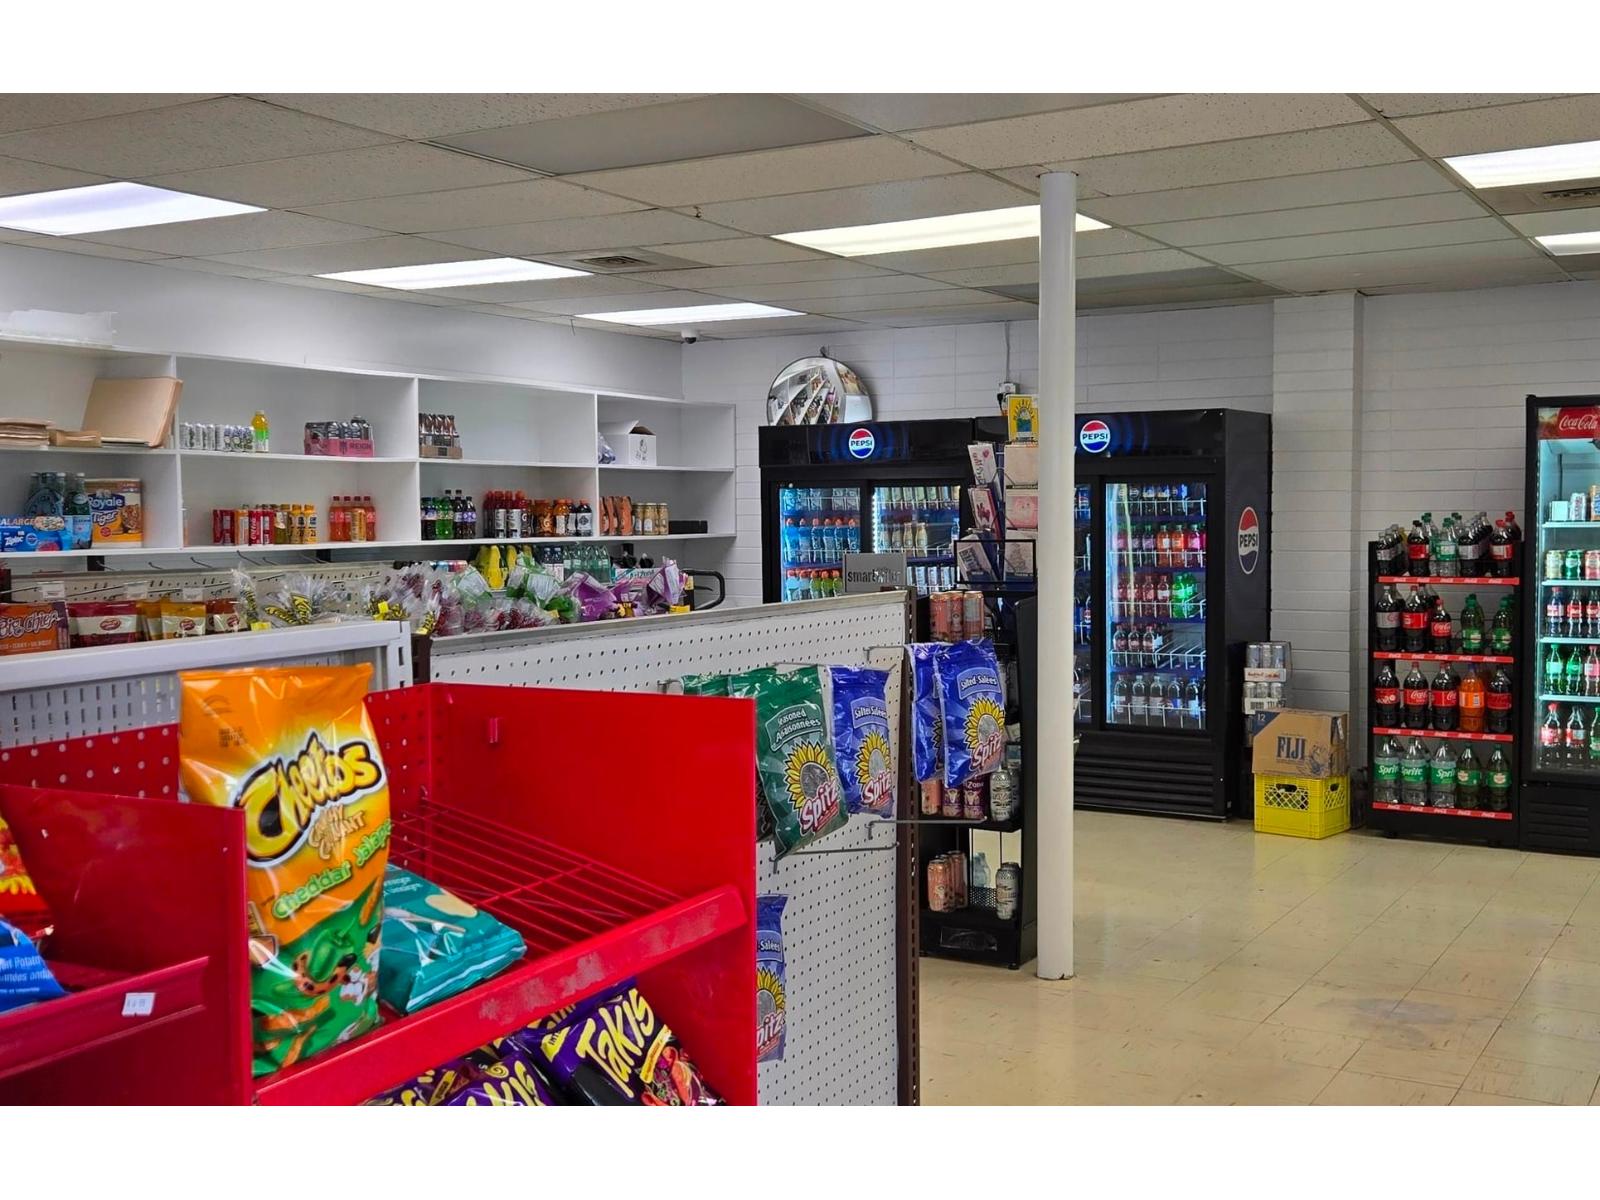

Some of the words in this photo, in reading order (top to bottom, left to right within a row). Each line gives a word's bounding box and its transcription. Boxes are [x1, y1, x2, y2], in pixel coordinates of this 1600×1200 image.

[850, 439, 873, 447] PEPSI
[1082, 433, 1109, 441] PEPSI
[88, 497, 123, 509] Royale
[93, 511, 117, 526] Tiger
[1239, 533, 1259, 548] PEPSI
[1257, 713, 1266, 722] 12
[971, 734, 1003, 770] Spitz
[1277, 735, 1306, 760] FIJI
[237, 732, 381, 862] Cheetos
[863, 771, 893, 804] Spitz
[799, 780, 839, 836] Spitz
[272, 859, 352, 919] Cheddar
[576, 988, 655, 1099] Takis
[756, 1011, 784, 1047] pitz
